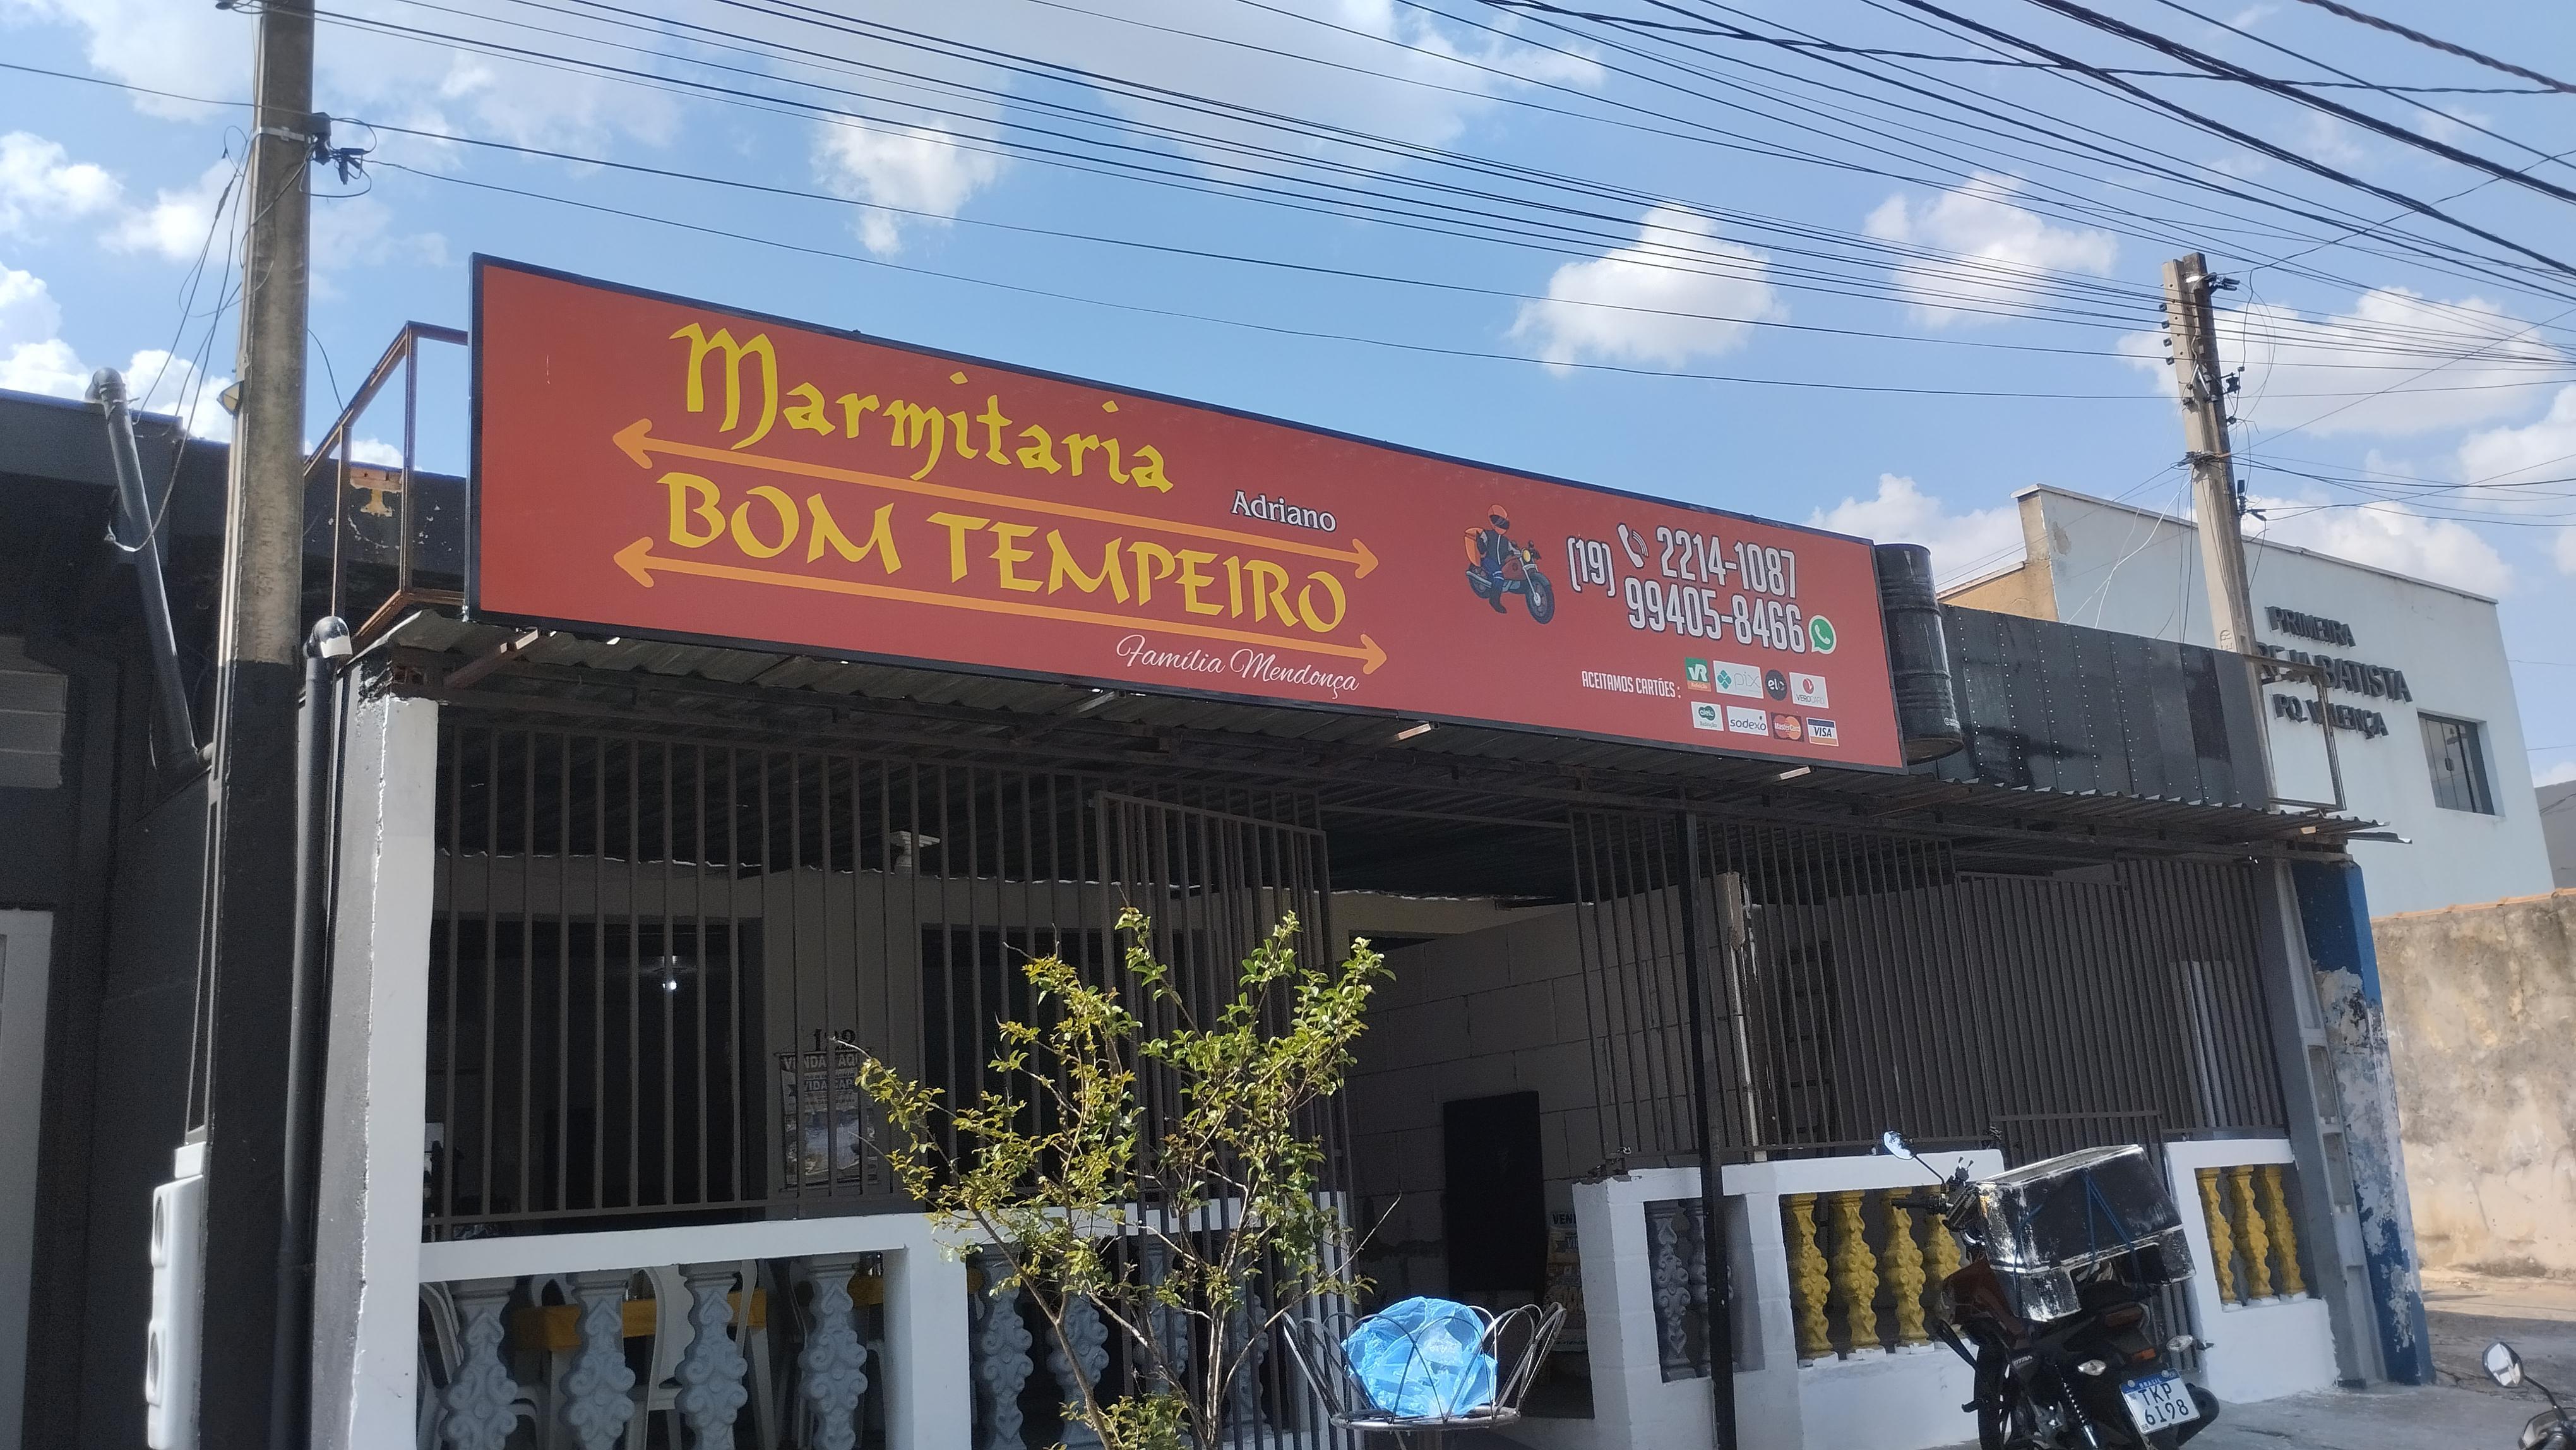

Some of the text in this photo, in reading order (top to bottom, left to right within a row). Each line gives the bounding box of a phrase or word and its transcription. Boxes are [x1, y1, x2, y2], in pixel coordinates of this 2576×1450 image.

[669, 322, 1174, 493] Marmitaria
[1230, 490, 1337, 532] Adriano
[657, 472, 1346, 632] BOM TEMPEIRO
[1566, 525, 1796, 599] (19) 2214-1087
[1625, 577, 1806, 654] 99405-8466
[2265, 606, 2356, 647] PRIMEIRA
[1116, 635, 1359, 699] Família Mendonça
[2313, 654, 2413, 703] BATISTA
[1581, 670, 1634, 693] ACEITAMOS
[1734, 671, 1761, 692] pix
[1768, 678, 1785, 692] elo
[1730, 718, 1767, 731] sodexo
[1813, 727, 1832, 738] VISA
[784, 1055, 826, 1070] VNDA
[2138, 1378, 2162, 1388] BRASIL
[2138, 1382, 2172, 1406] TKP
[2145, 1399, 2189, 1425] 6198
